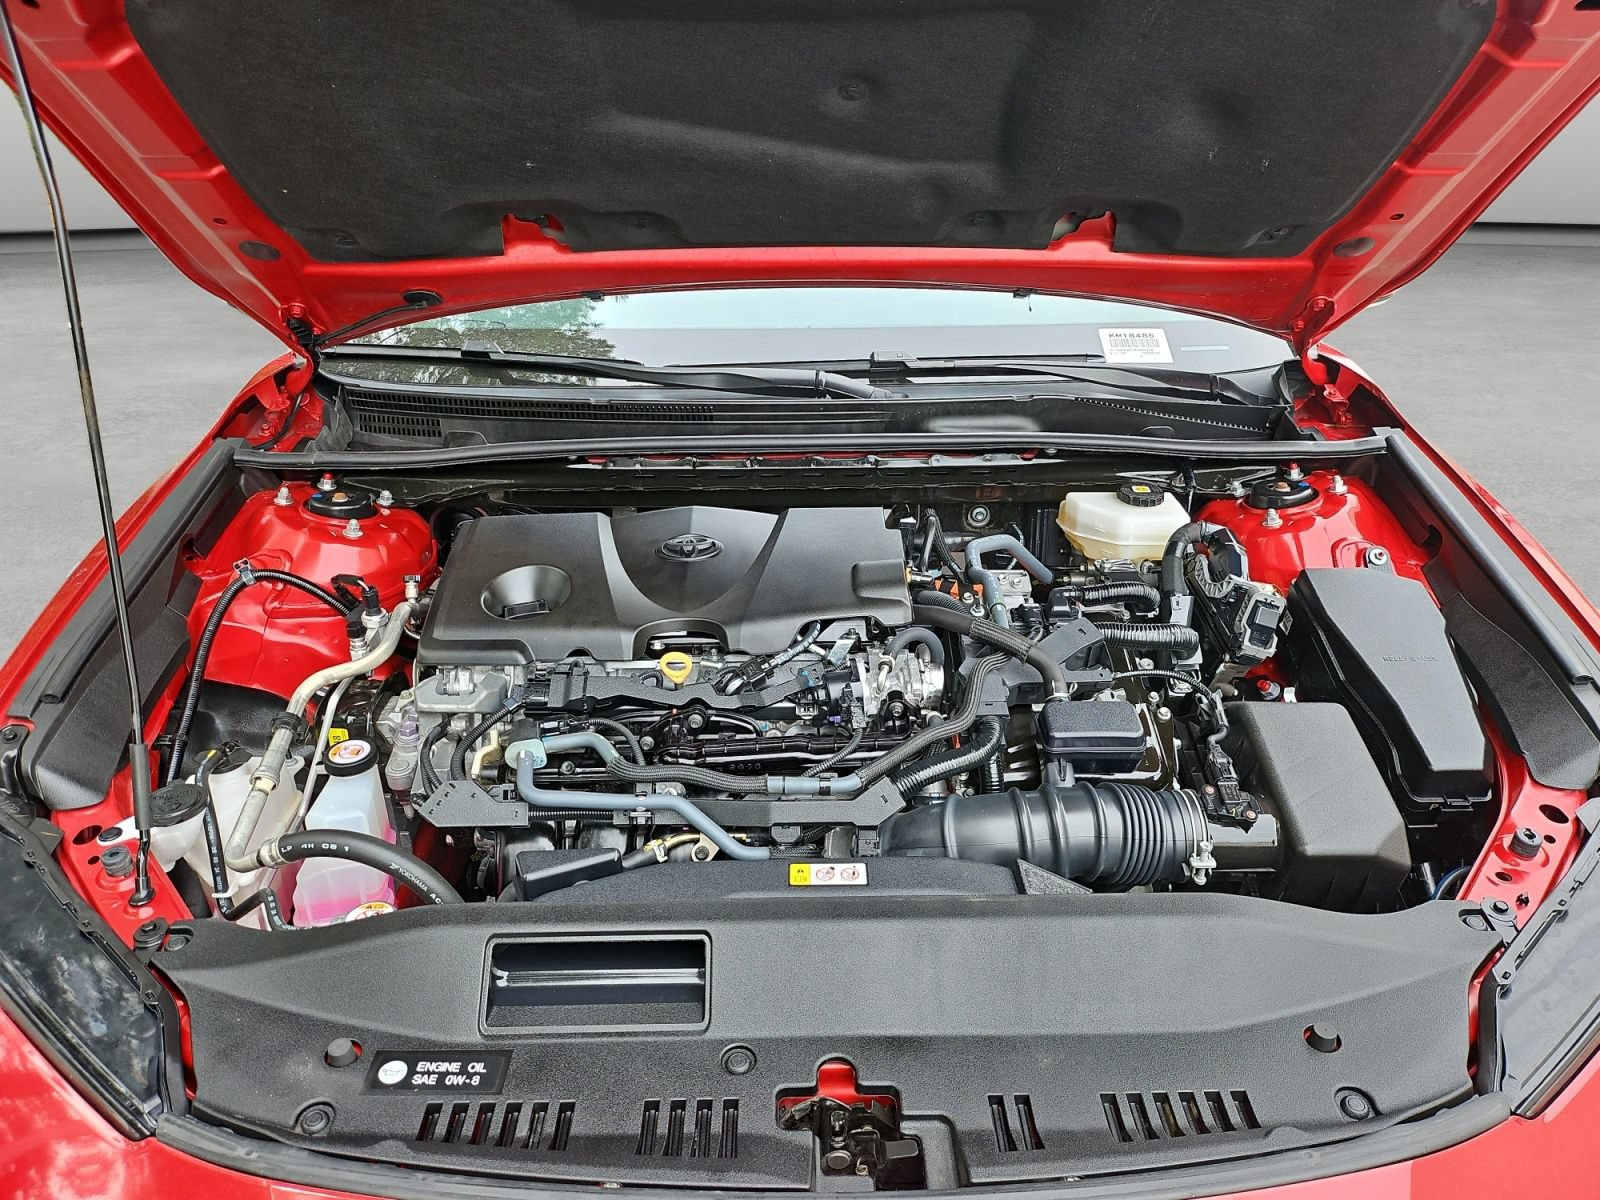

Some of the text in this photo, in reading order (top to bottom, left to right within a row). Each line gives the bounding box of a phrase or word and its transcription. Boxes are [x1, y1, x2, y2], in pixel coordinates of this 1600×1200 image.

[281, 845, 293, 853] LP
[398, 867, 429, 892] YOKOHAMA
[415, 1062, 487, 1073] ENGINE OIL
[411, 1074, 481, 1086] SAE 0W-8
